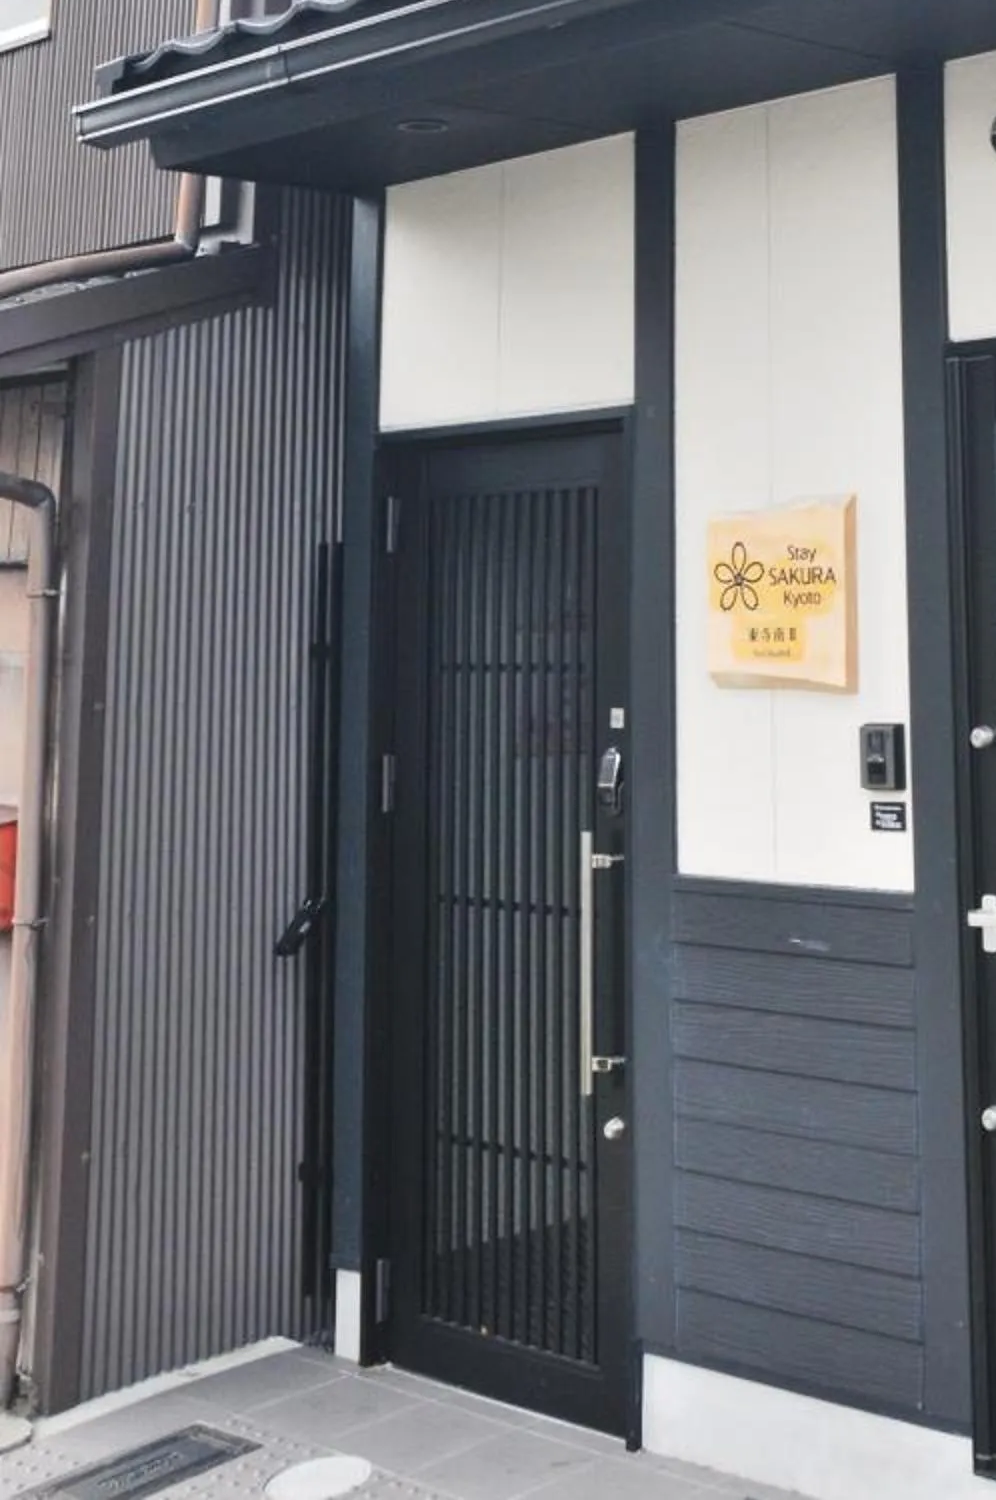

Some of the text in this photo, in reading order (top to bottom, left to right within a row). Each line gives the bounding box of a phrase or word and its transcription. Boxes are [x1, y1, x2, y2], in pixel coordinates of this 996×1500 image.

[787, 545, 817, 564] Stay
[768, 566, 837, 586] SAKURA
[783, 590, 822, 608] Kyoto
